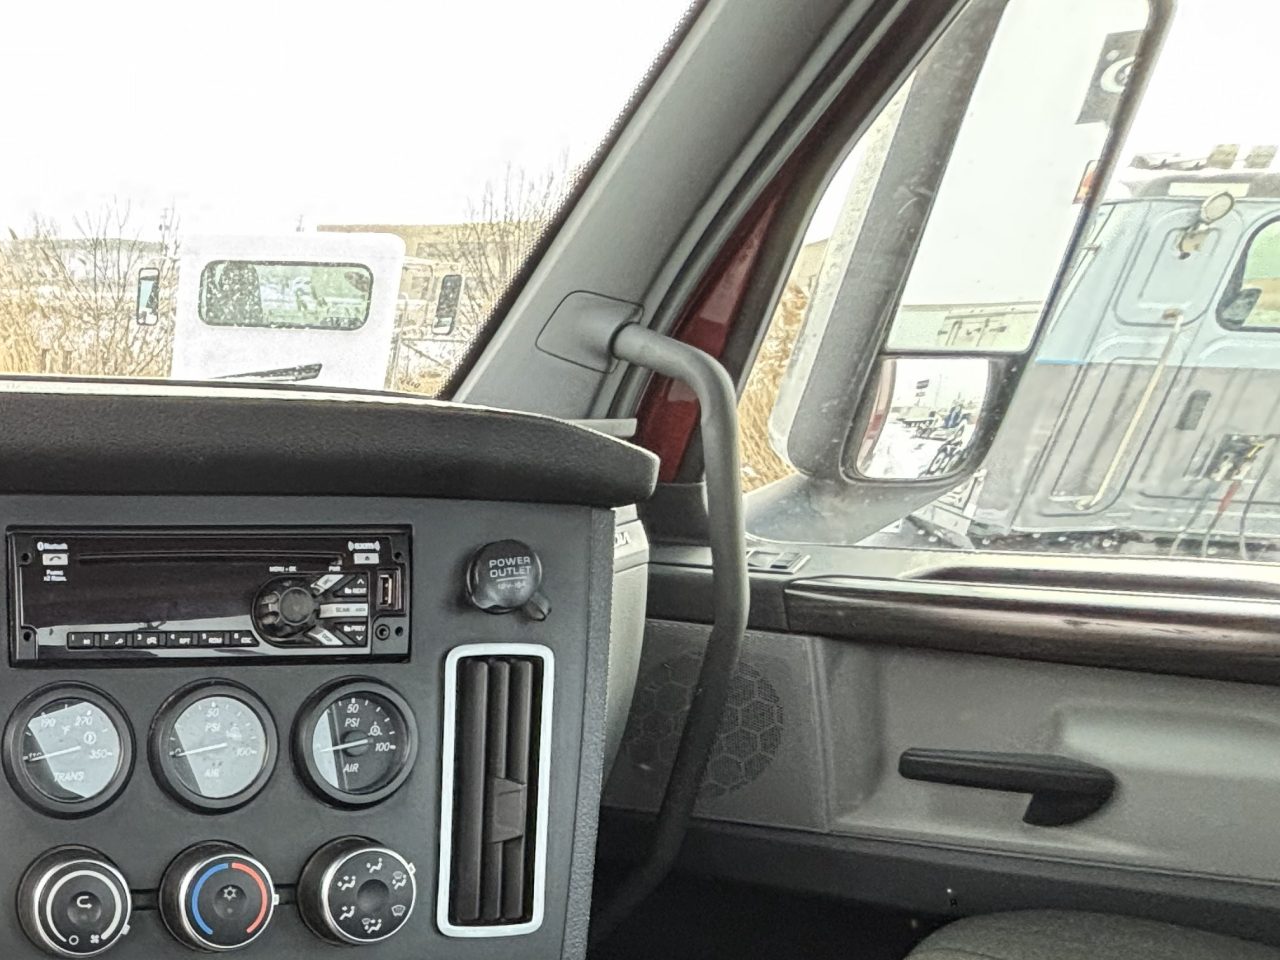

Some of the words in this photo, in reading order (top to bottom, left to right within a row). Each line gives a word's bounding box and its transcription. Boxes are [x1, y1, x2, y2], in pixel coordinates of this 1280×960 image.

[489, 556, 531, 568] POWER
[490, 566, 532, 578] OUTLET
[206, 707, 220, 718] 50
[346, 703, 359, 713] 50
[74, 715, 93, 727] 270
[344, 717, 360, 728] PSI
[205, 722, 220, 733] PSI
[236, 747, 251, 757] 100
[375, 742, 390, 752] 100
[89, 749, 107, 759] 350
[205, 768, 220, 777] AIR
[343, 763, 359, 772] AIR
[54, 771, 85, 782] TRANS
